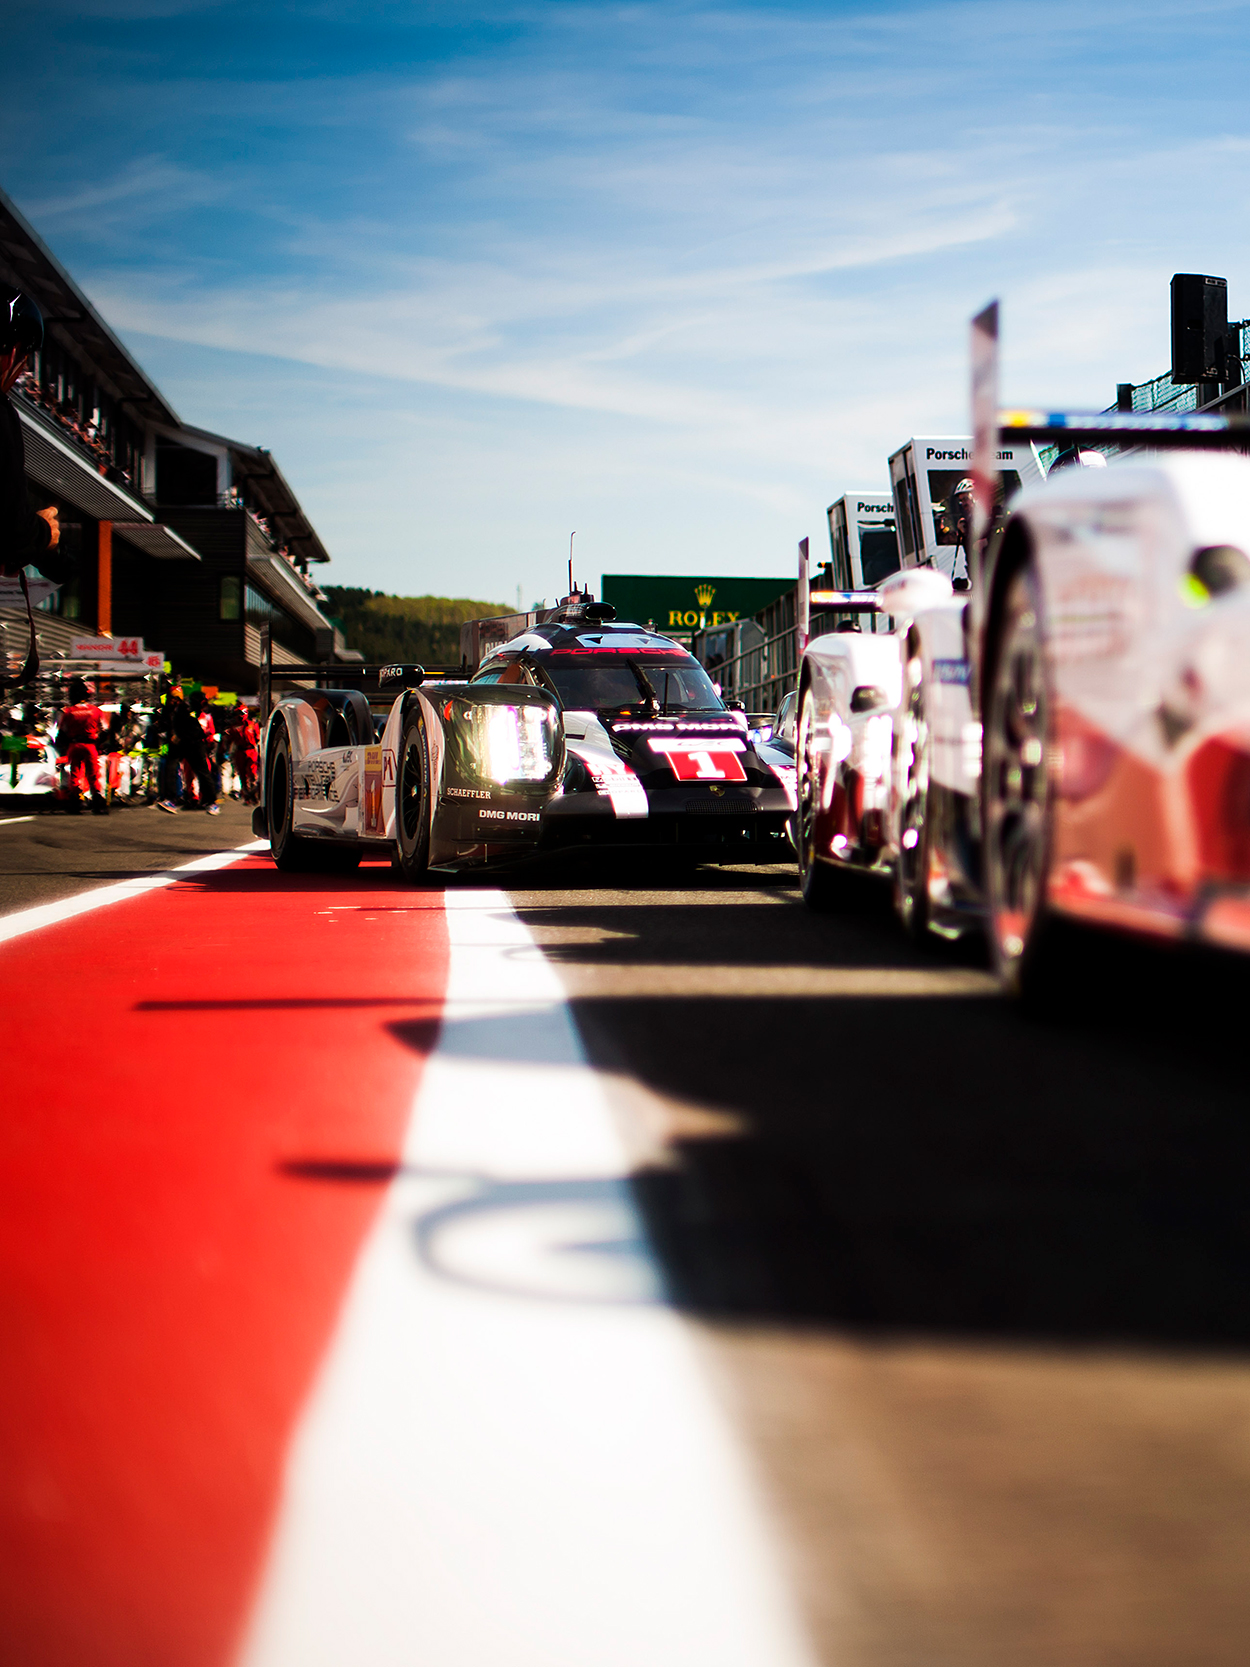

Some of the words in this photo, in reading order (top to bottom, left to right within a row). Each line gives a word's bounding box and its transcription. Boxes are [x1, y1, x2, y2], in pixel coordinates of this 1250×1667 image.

[857, 502, 894, 513] Porsch
[668, 610, 740, 627] ROLEX
[117, 639, 138, 656] 44
[550, 647, 690, 658] PORSCHE
[611, 723, 675, 732] DMG
[687, 751, 726, 778] 1
[447, 787, 492, 800] SCHAEFFLER
[479, 809, 505, 819] DMG
[506, 811, 540, 822] MORI
